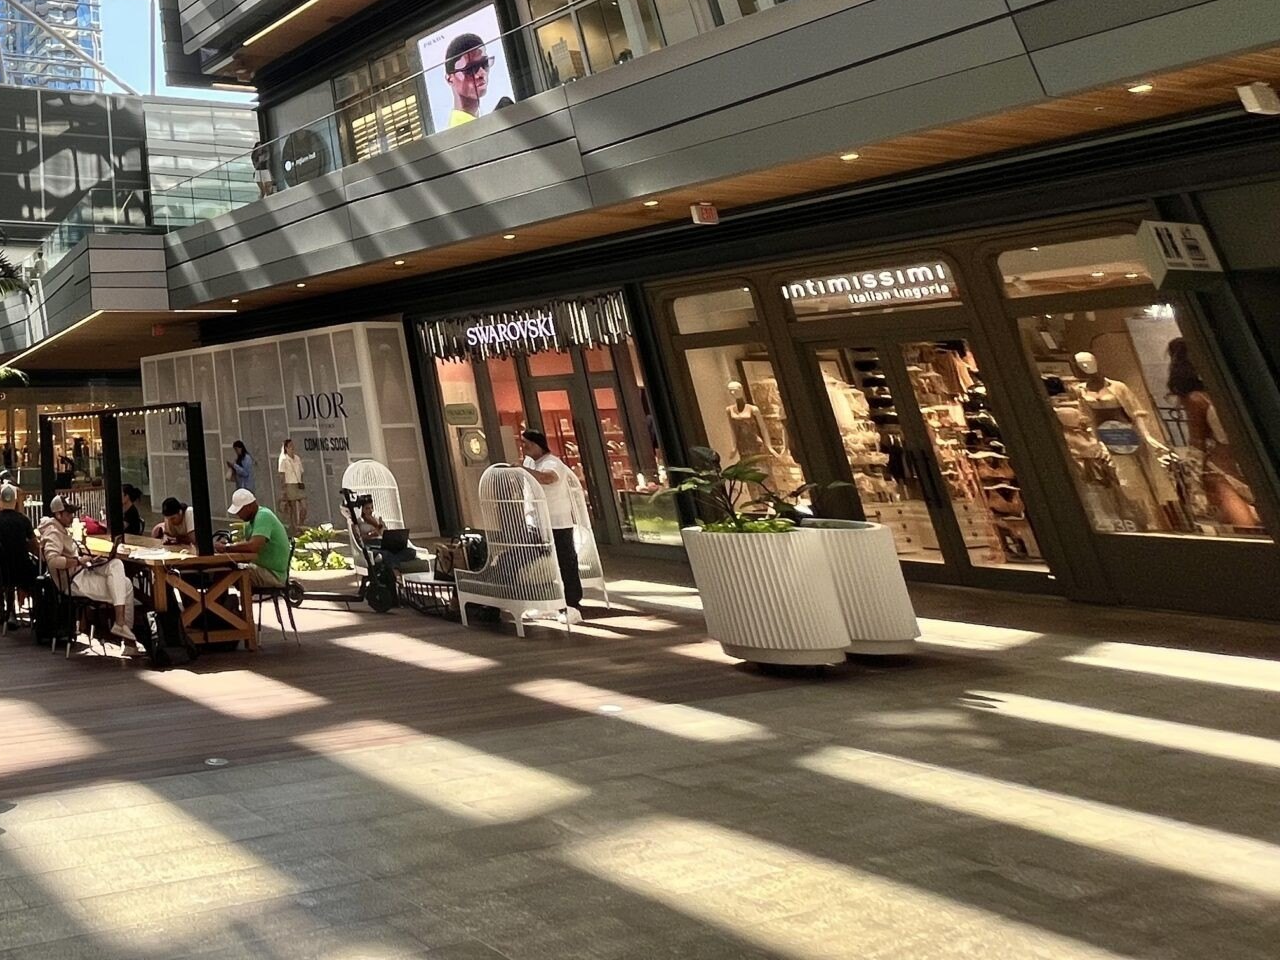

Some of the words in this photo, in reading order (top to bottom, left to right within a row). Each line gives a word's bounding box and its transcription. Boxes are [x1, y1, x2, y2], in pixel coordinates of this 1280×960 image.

[466, 316, 556, 346] SWAROVSKI
[296, 391, 348, 420] DIOR
[304, 437, 329, 451] COMING
[330, 437, 350, 451] SOON
